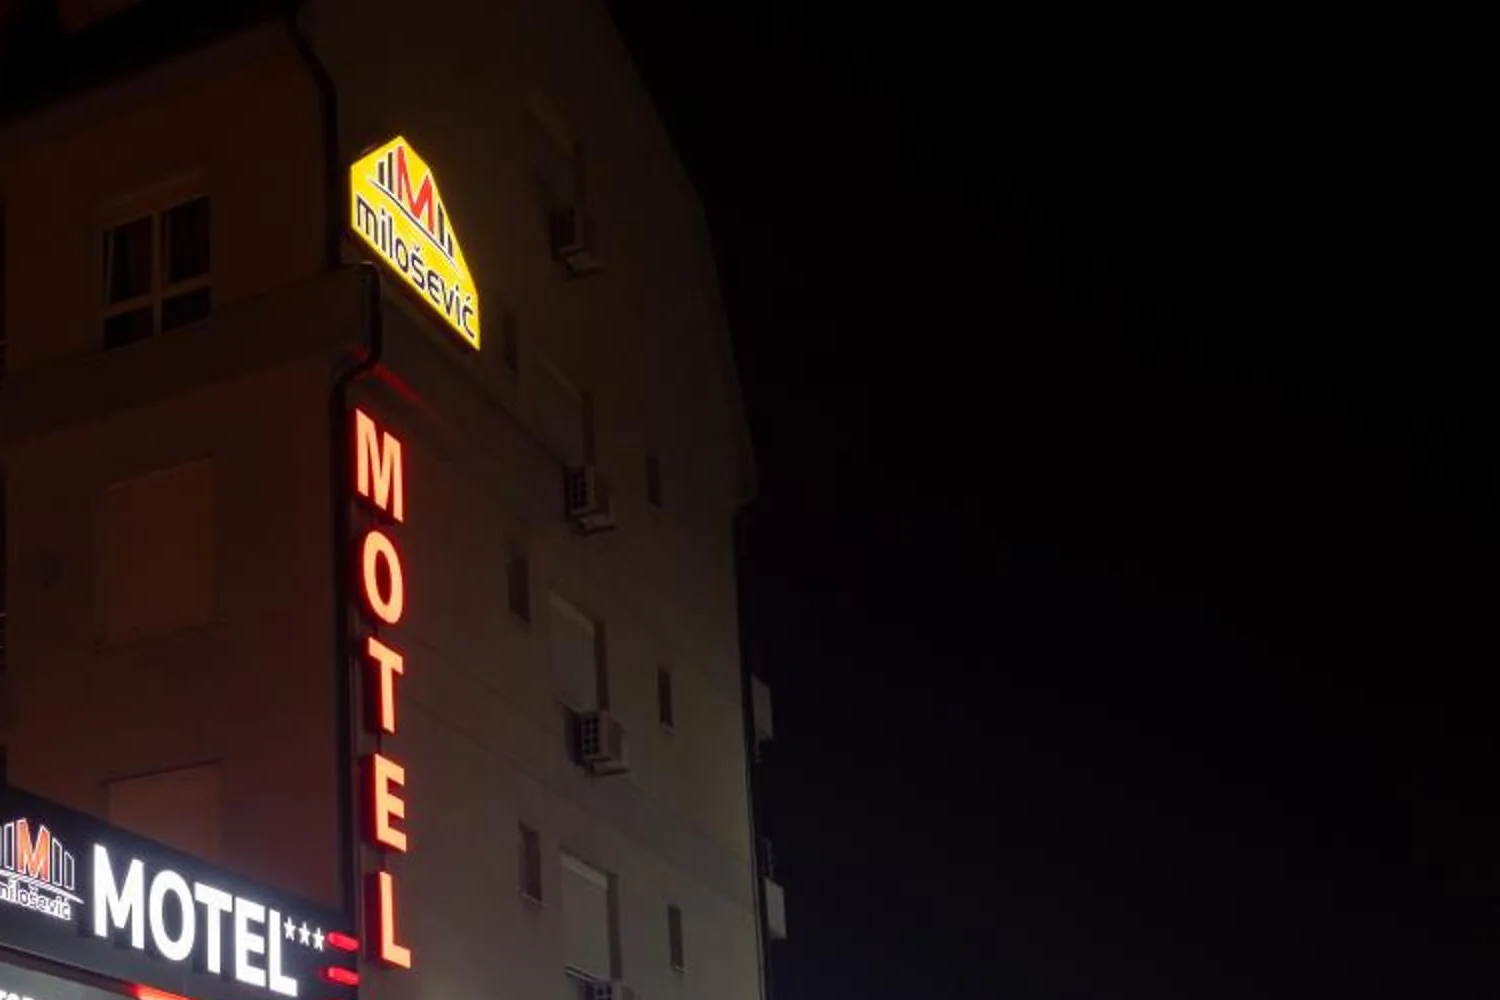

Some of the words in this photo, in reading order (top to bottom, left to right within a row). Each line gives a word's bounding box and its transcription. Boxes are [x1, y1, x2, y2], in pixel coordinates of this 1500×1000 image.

[356, 197, 475, 338] milošević
[355, 408, 411, 969] MOTEL
[94, 843, 298, 997] MOTEL
